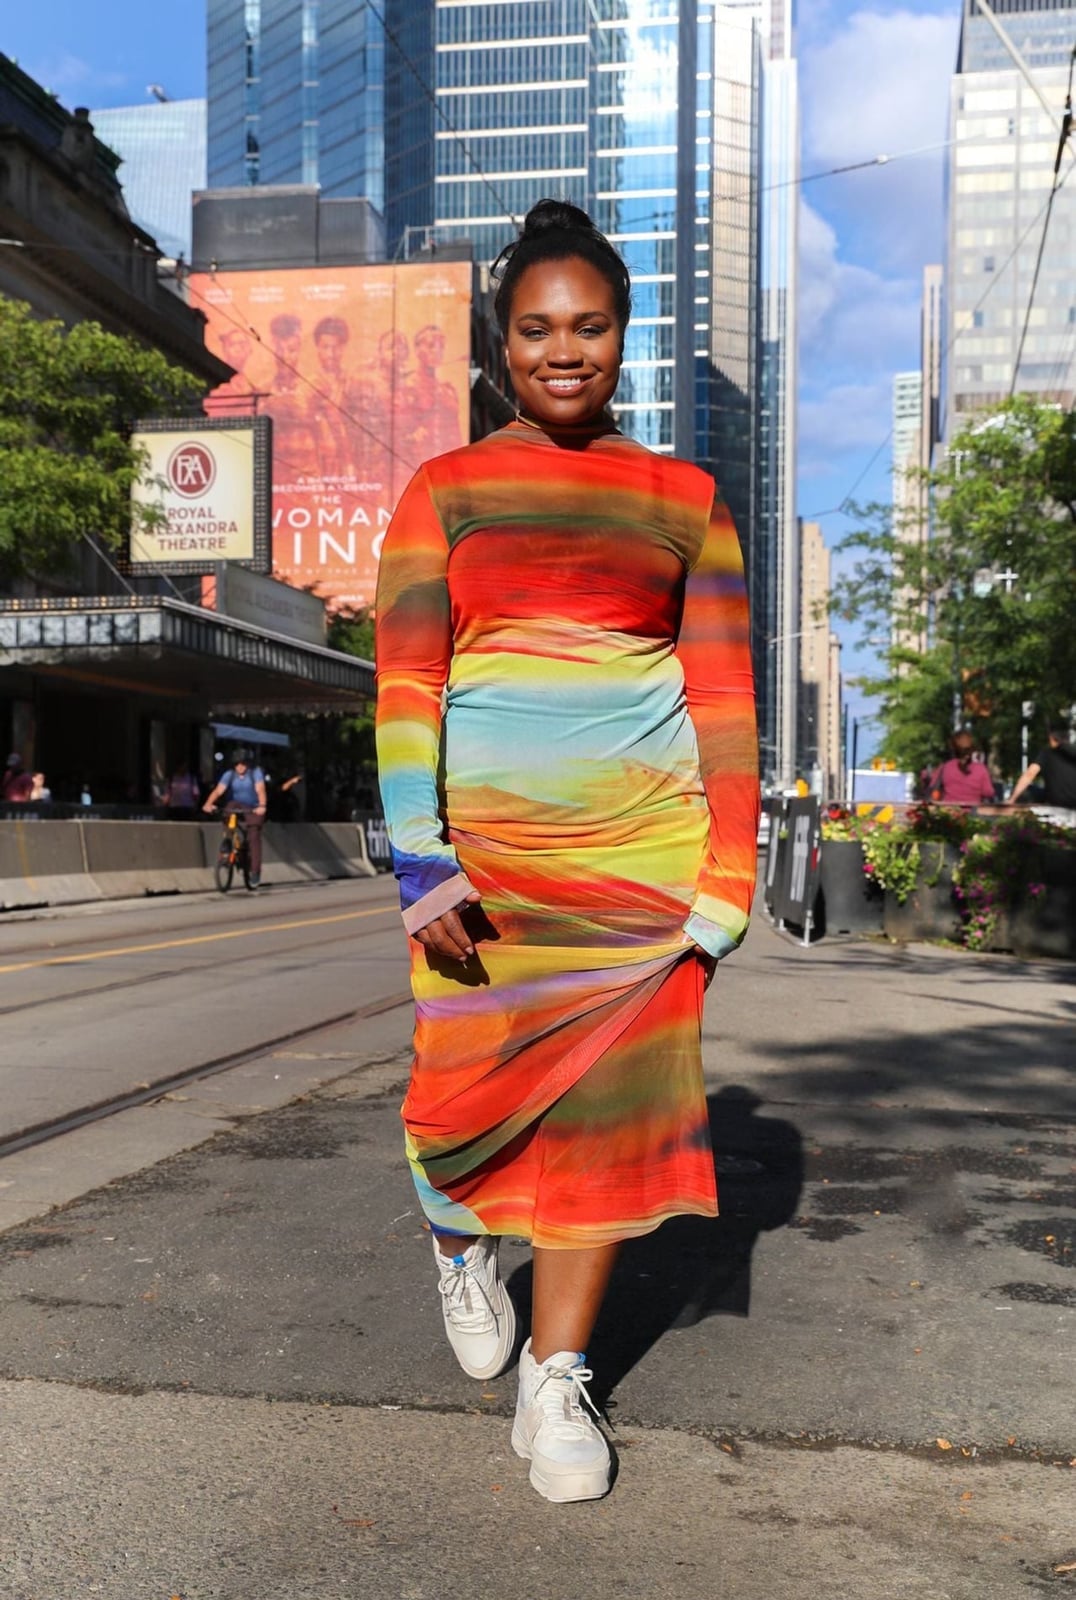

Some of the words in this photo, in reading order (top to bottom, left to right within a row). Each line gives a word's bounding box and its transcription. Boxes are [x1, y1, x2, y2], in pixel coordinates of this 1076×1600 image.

[313, 495, 342, 504] THE
[167, 507, 216, 519] ROYAL
[158, 537, 227, 551] THEATRE
